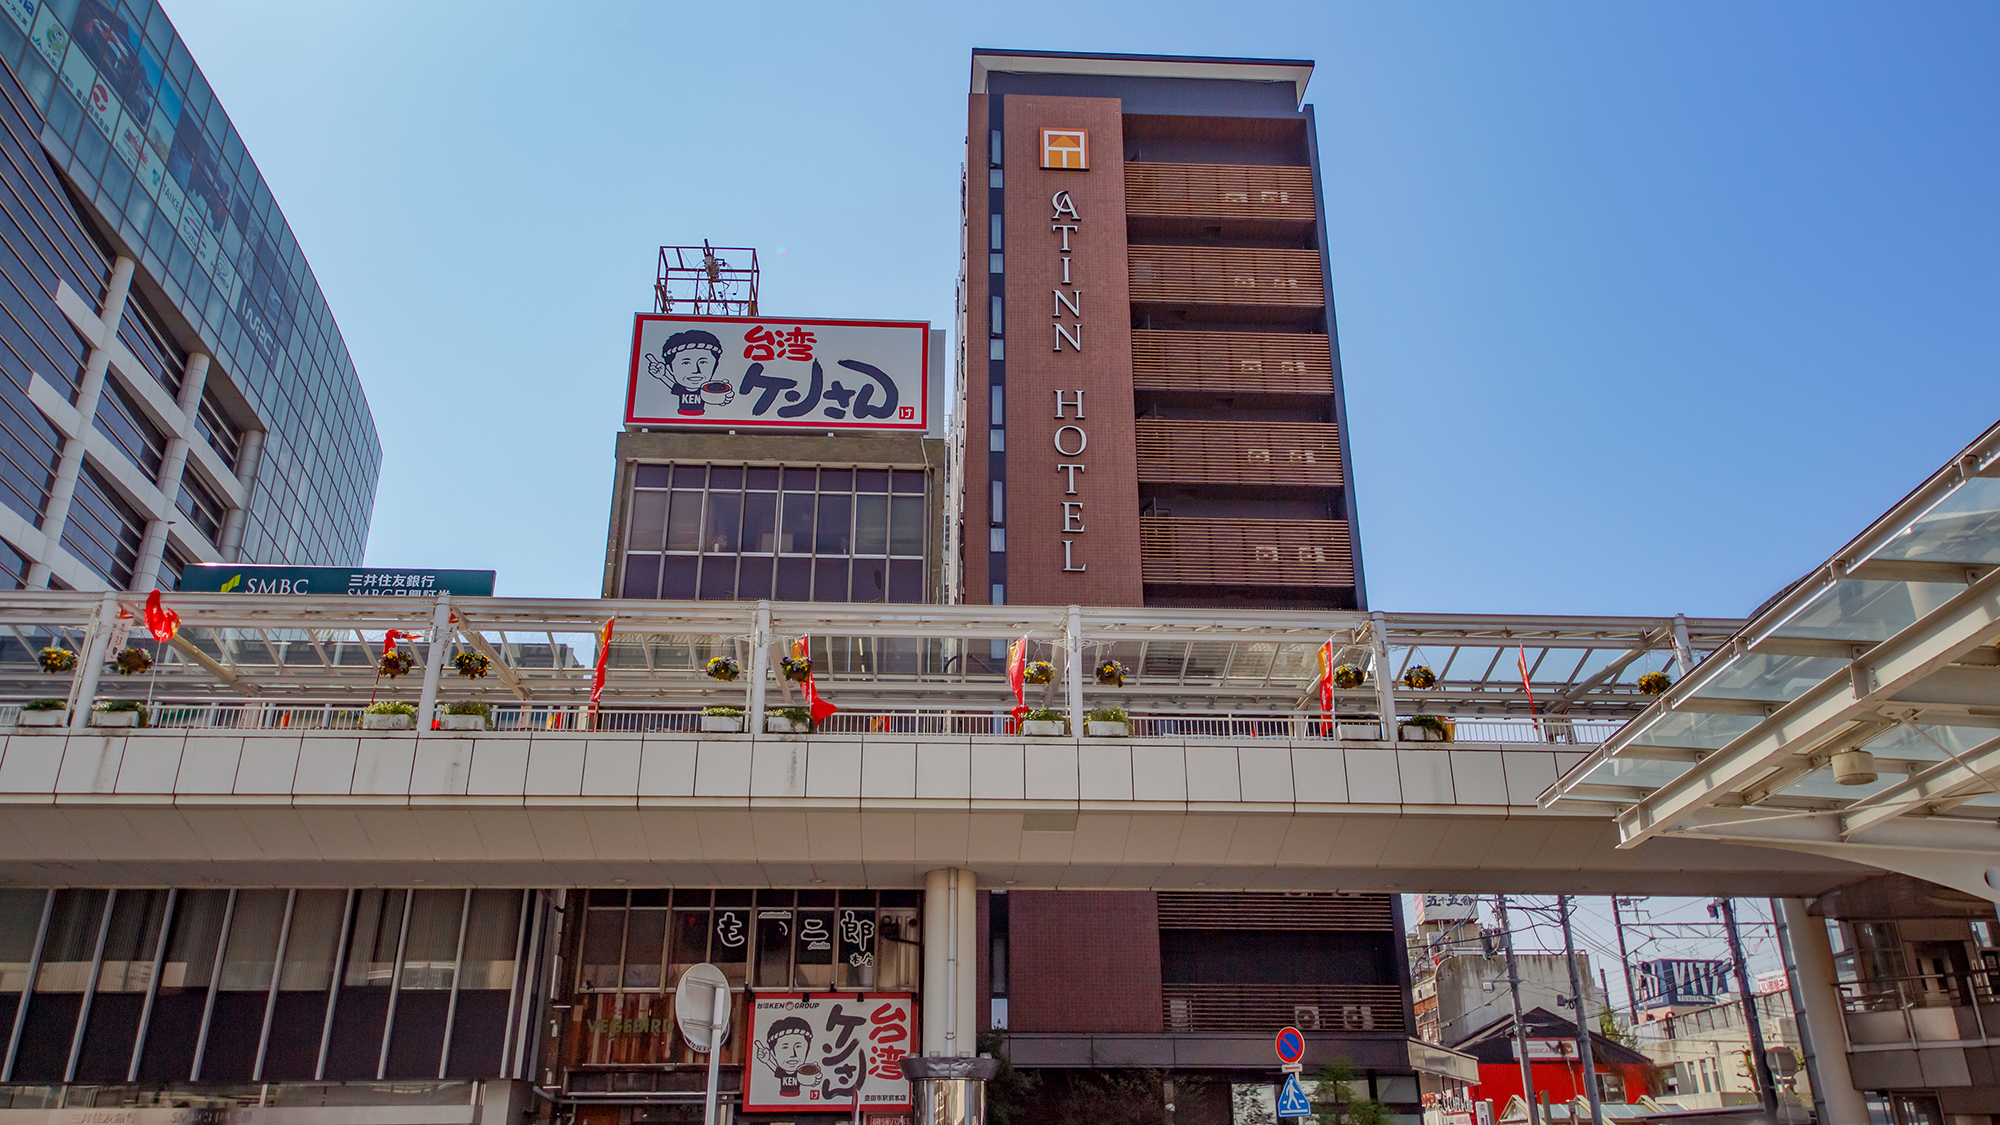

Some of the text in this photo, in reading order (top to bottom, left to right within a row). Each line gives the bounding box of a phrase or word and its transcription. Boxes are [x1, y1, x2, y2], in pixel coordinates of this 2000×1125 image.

[743, 324, 818, 362] 台湾
[739, 357, 899, 420] ケンさん
[681, 393, 702, 405] KEN
[1053, 389, 1088, 573] HOTEL
[245, 578, 309, 595] SMBC
[348, 574, 436, 588] 三井住友銀行
[850, 952, 874, 968] 本店
[586, 1018, 675, 1034] VEGEBIRD
[868, 1003, 908, 1081] 台湾
[821, 1003, 867, 1100] ケンさん
[782, 1076, 798, 1086] KEN
